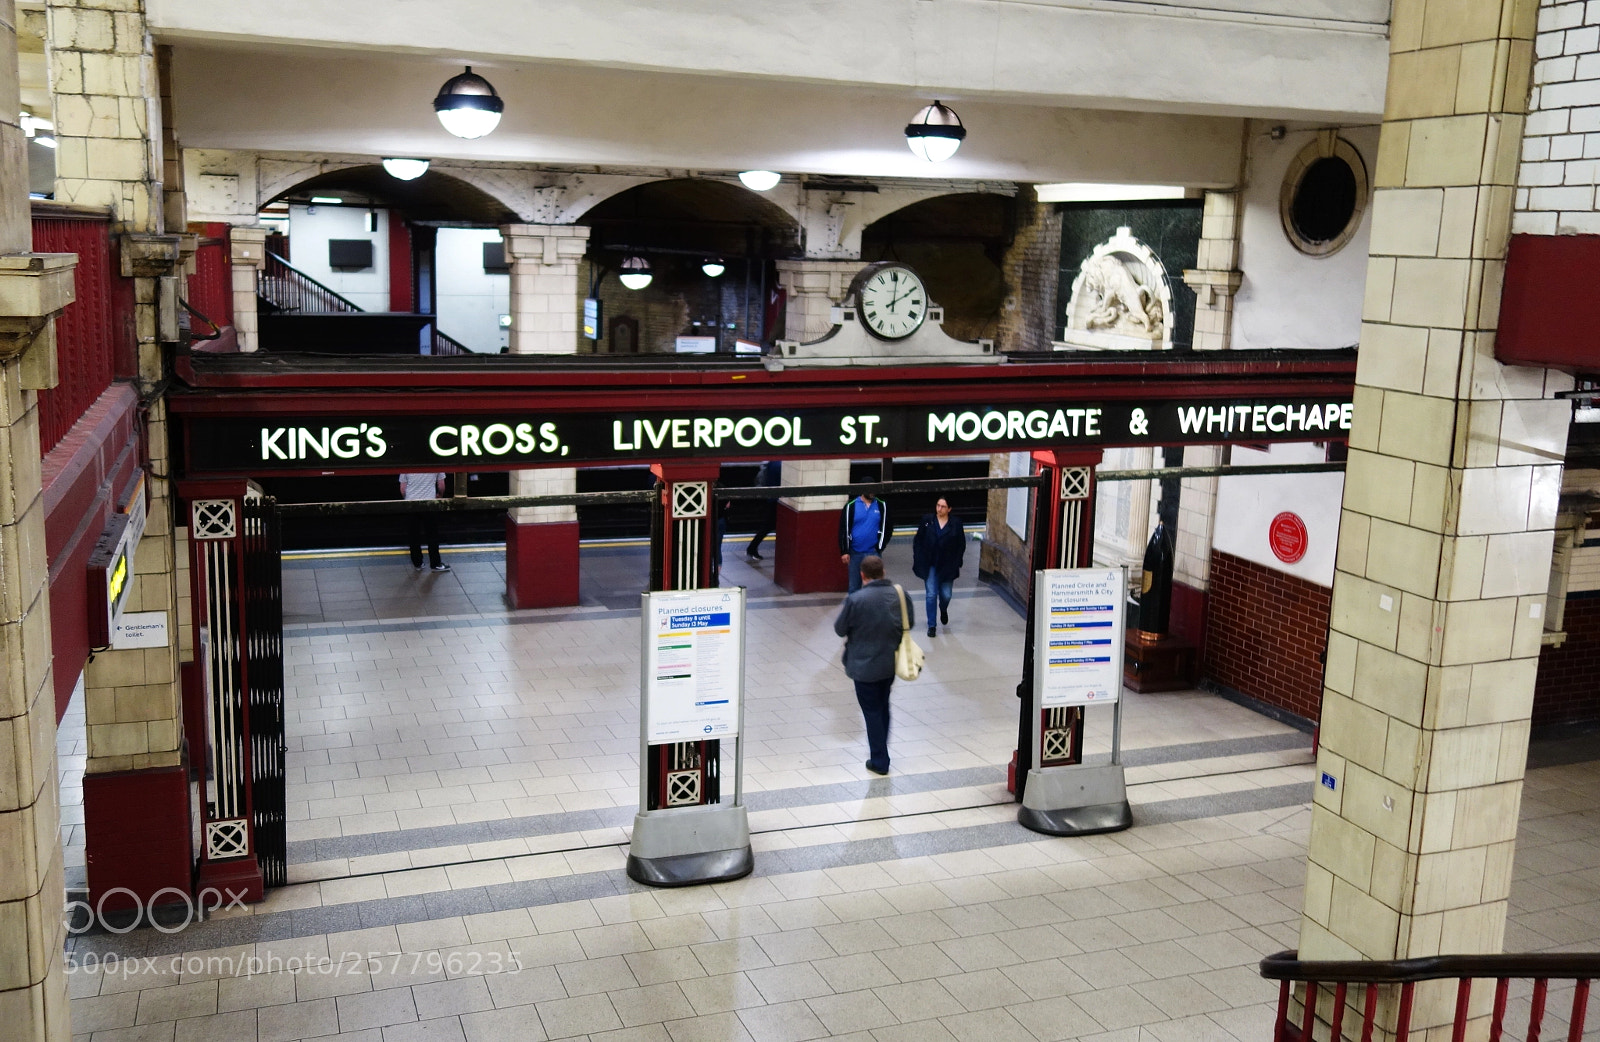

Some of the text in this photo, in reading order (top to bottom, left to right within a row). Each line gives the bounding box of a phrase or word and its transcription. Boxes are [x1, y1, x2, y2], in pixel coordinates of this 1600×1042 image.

[261, 422, 387, 460] KING'S
[428, 422, 570, 457] CROSS,
[613, 416, 812, 450] LIVERPOOL
[927, 408, 1102, 443] MOORGATE
[1128, 407, 1149, 436] &
[658, 605, 723, 615] Planned closures
